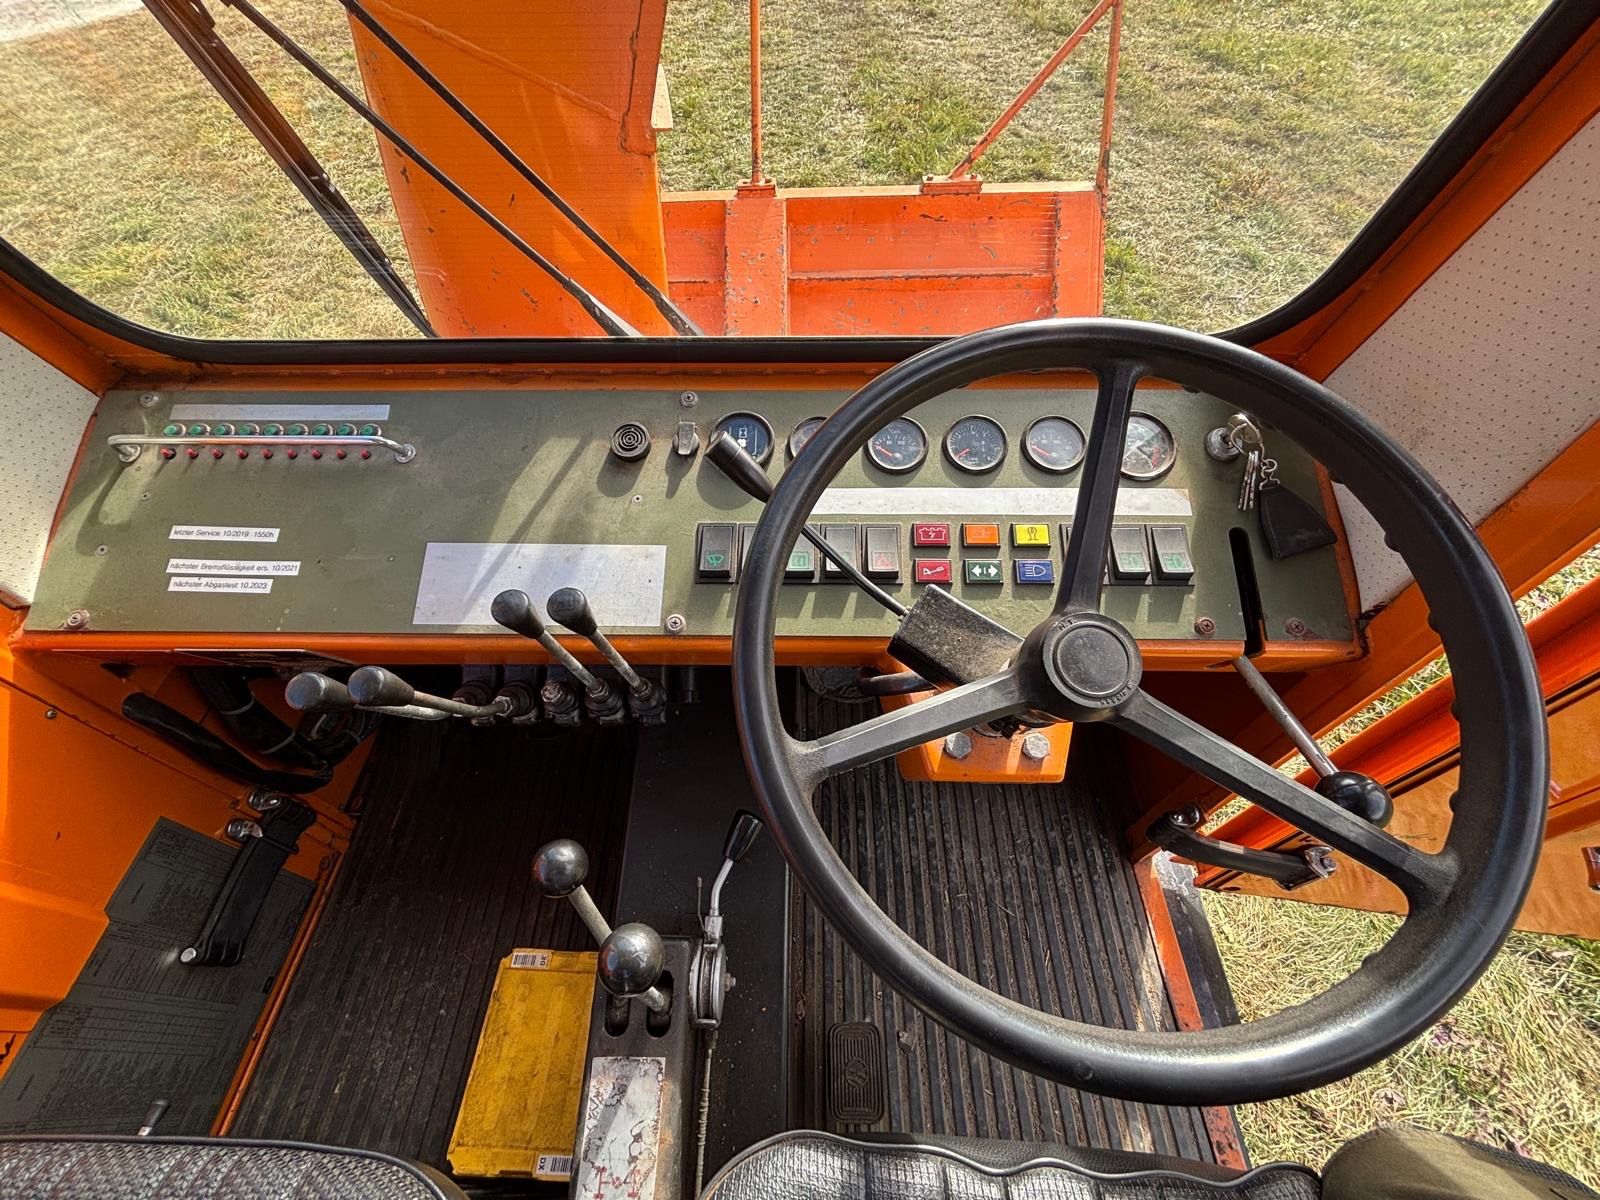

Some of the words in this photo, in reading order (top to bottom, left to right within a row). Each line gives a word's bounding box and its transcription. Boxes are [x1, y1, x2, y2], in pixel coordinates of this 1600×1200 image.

[195, 529, 221, 537] Service
[223, 530, 249, 538] 10/2019
[203, 582, 239, 590] Abgastest
